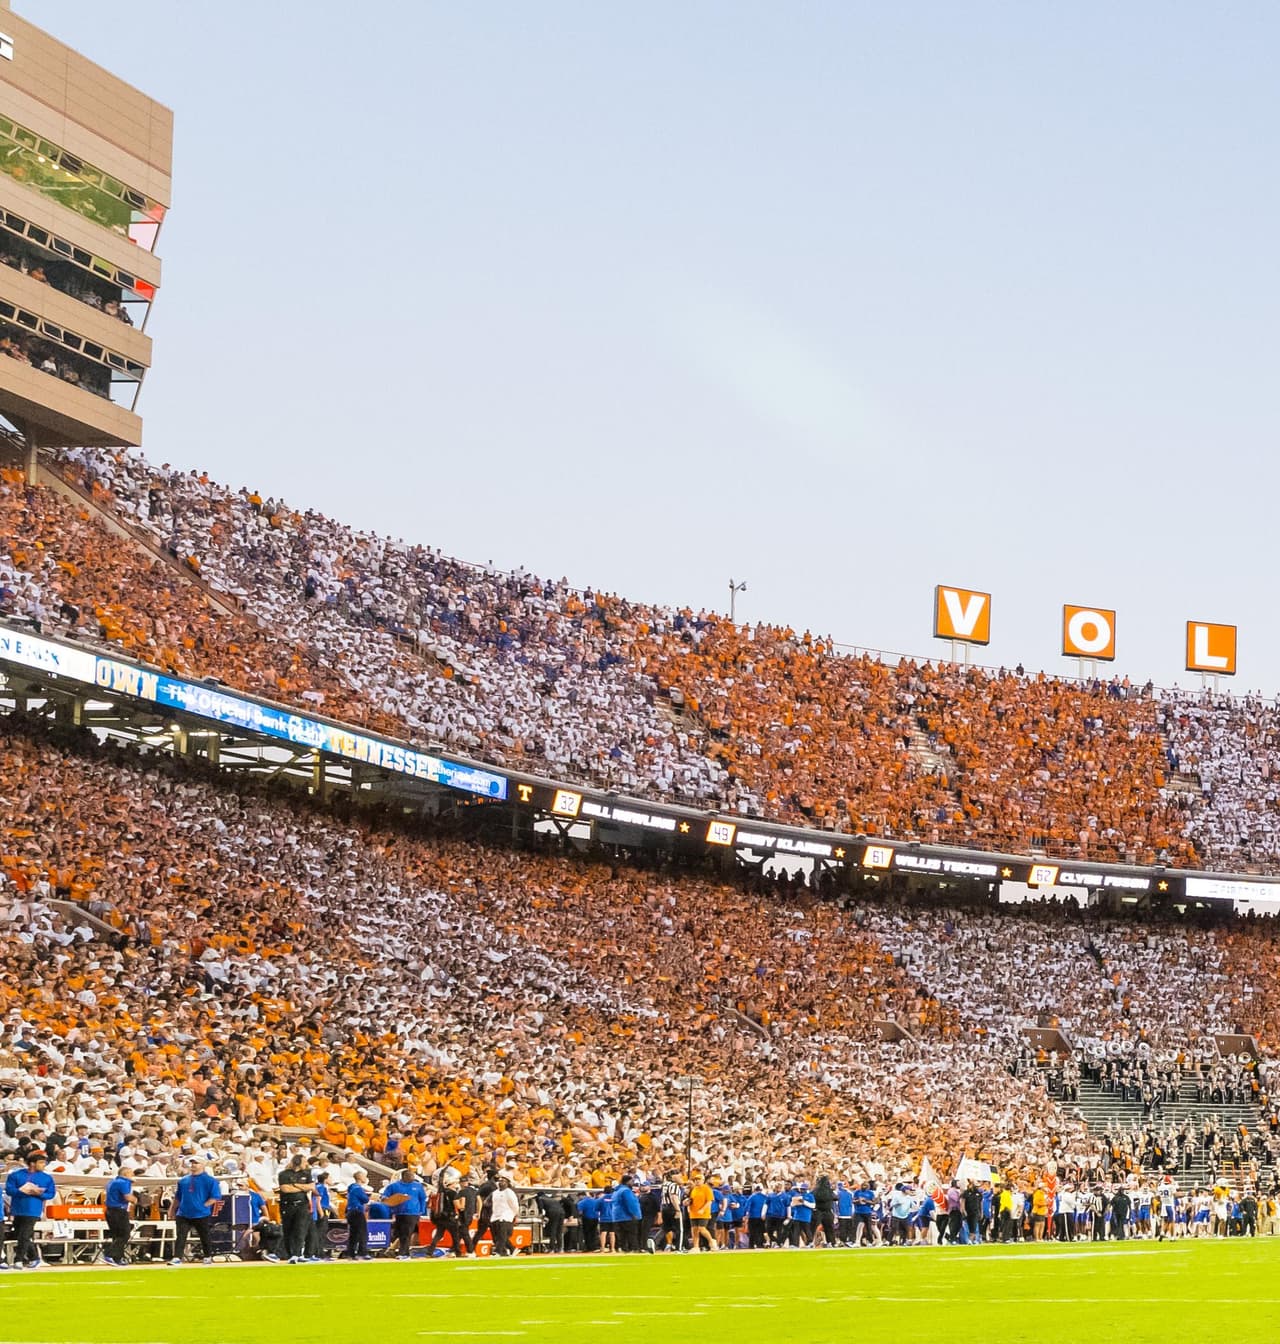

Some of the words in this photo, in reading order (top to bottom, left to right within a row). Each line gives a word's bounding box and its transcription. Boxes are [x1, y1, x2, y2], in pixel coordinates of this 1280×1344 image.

[943, 590, 986, 636] V
[1068, 610, 1112, 653] O
[1194, 625, 1229, 668] L
[329, 732, 440, 782] TENNESSEE
[517, 784, 533, 802] T
